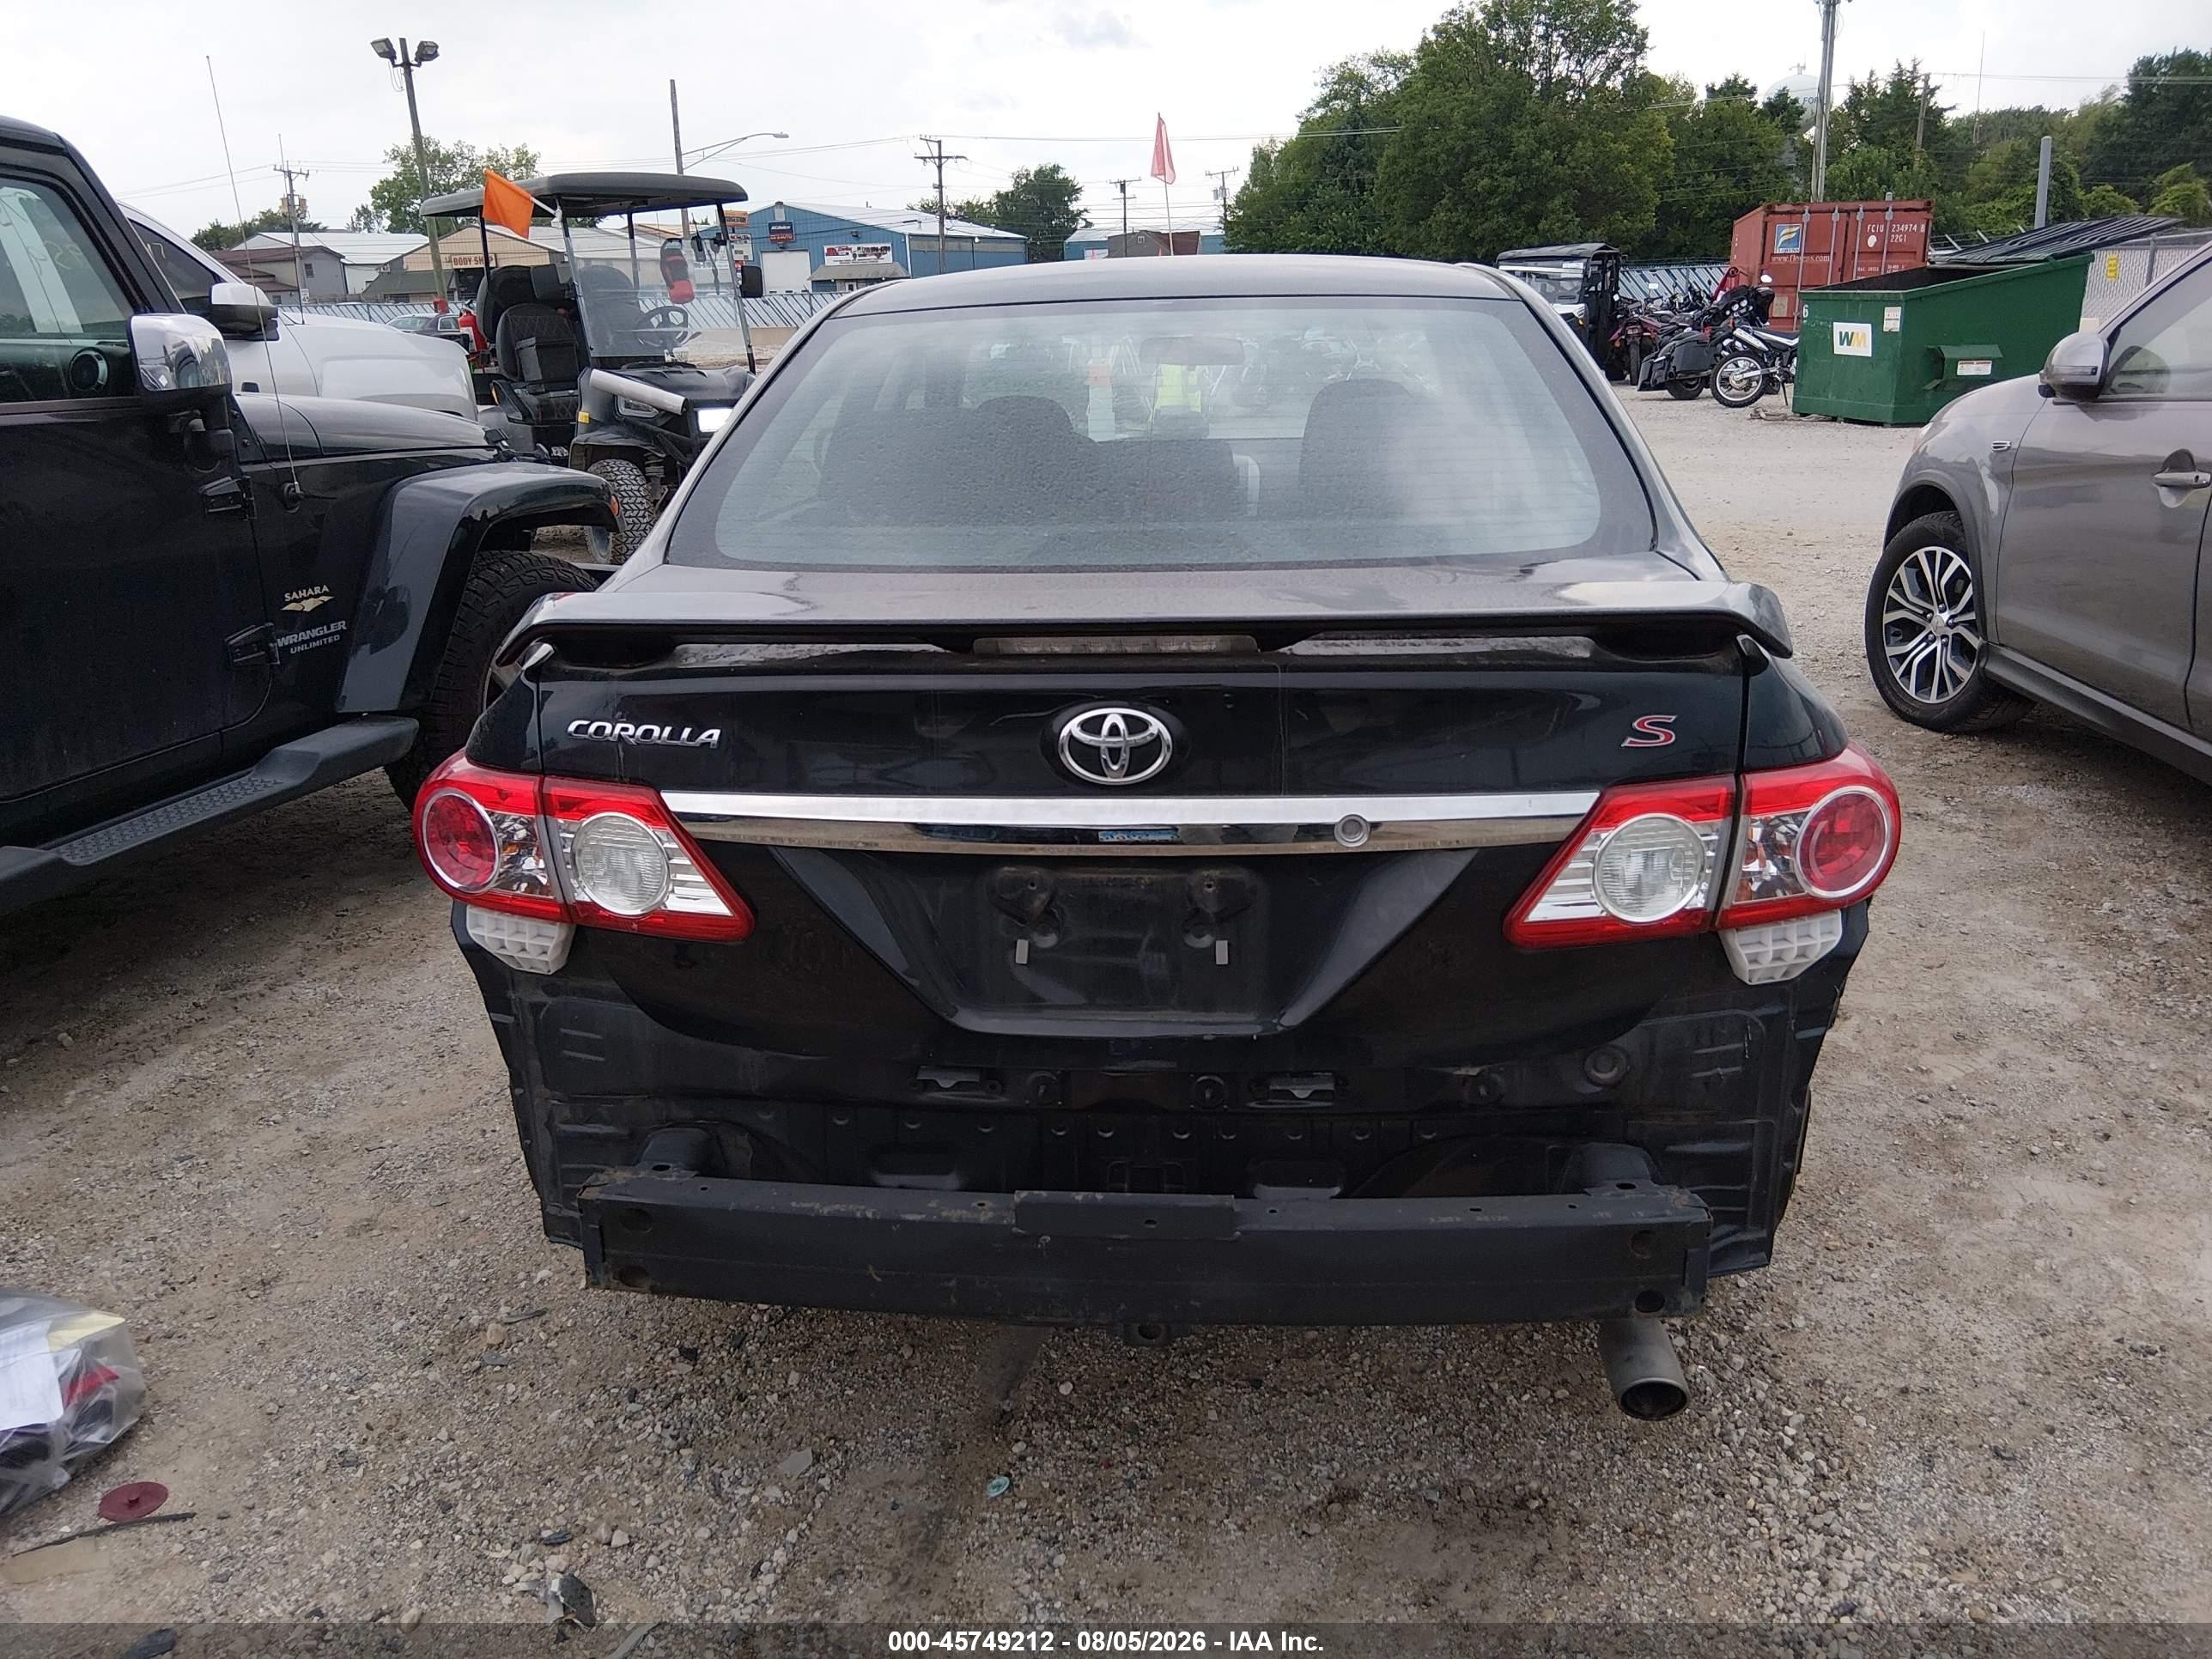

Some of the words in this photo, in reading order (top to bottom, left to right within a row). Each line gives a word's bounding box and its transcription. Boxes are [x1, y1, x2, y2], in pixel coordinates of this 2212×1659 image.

[1867, 224, 1884, 234] FCIU
[1892, 223, 1917, 234] 234974
[453, 257, 472, 266] BODY
[474, 256, 493, 265] SHP
[1838, 331, 1867, 348] WM
[284, 585, 330, 602] SAHARA
[276, 620, 348, 647] WRANGLER
[290, 634, 341, 654] UNLIMITED
[567, 720, 721, 749] COROLLA
[1621, 714, 1677, 747] S
